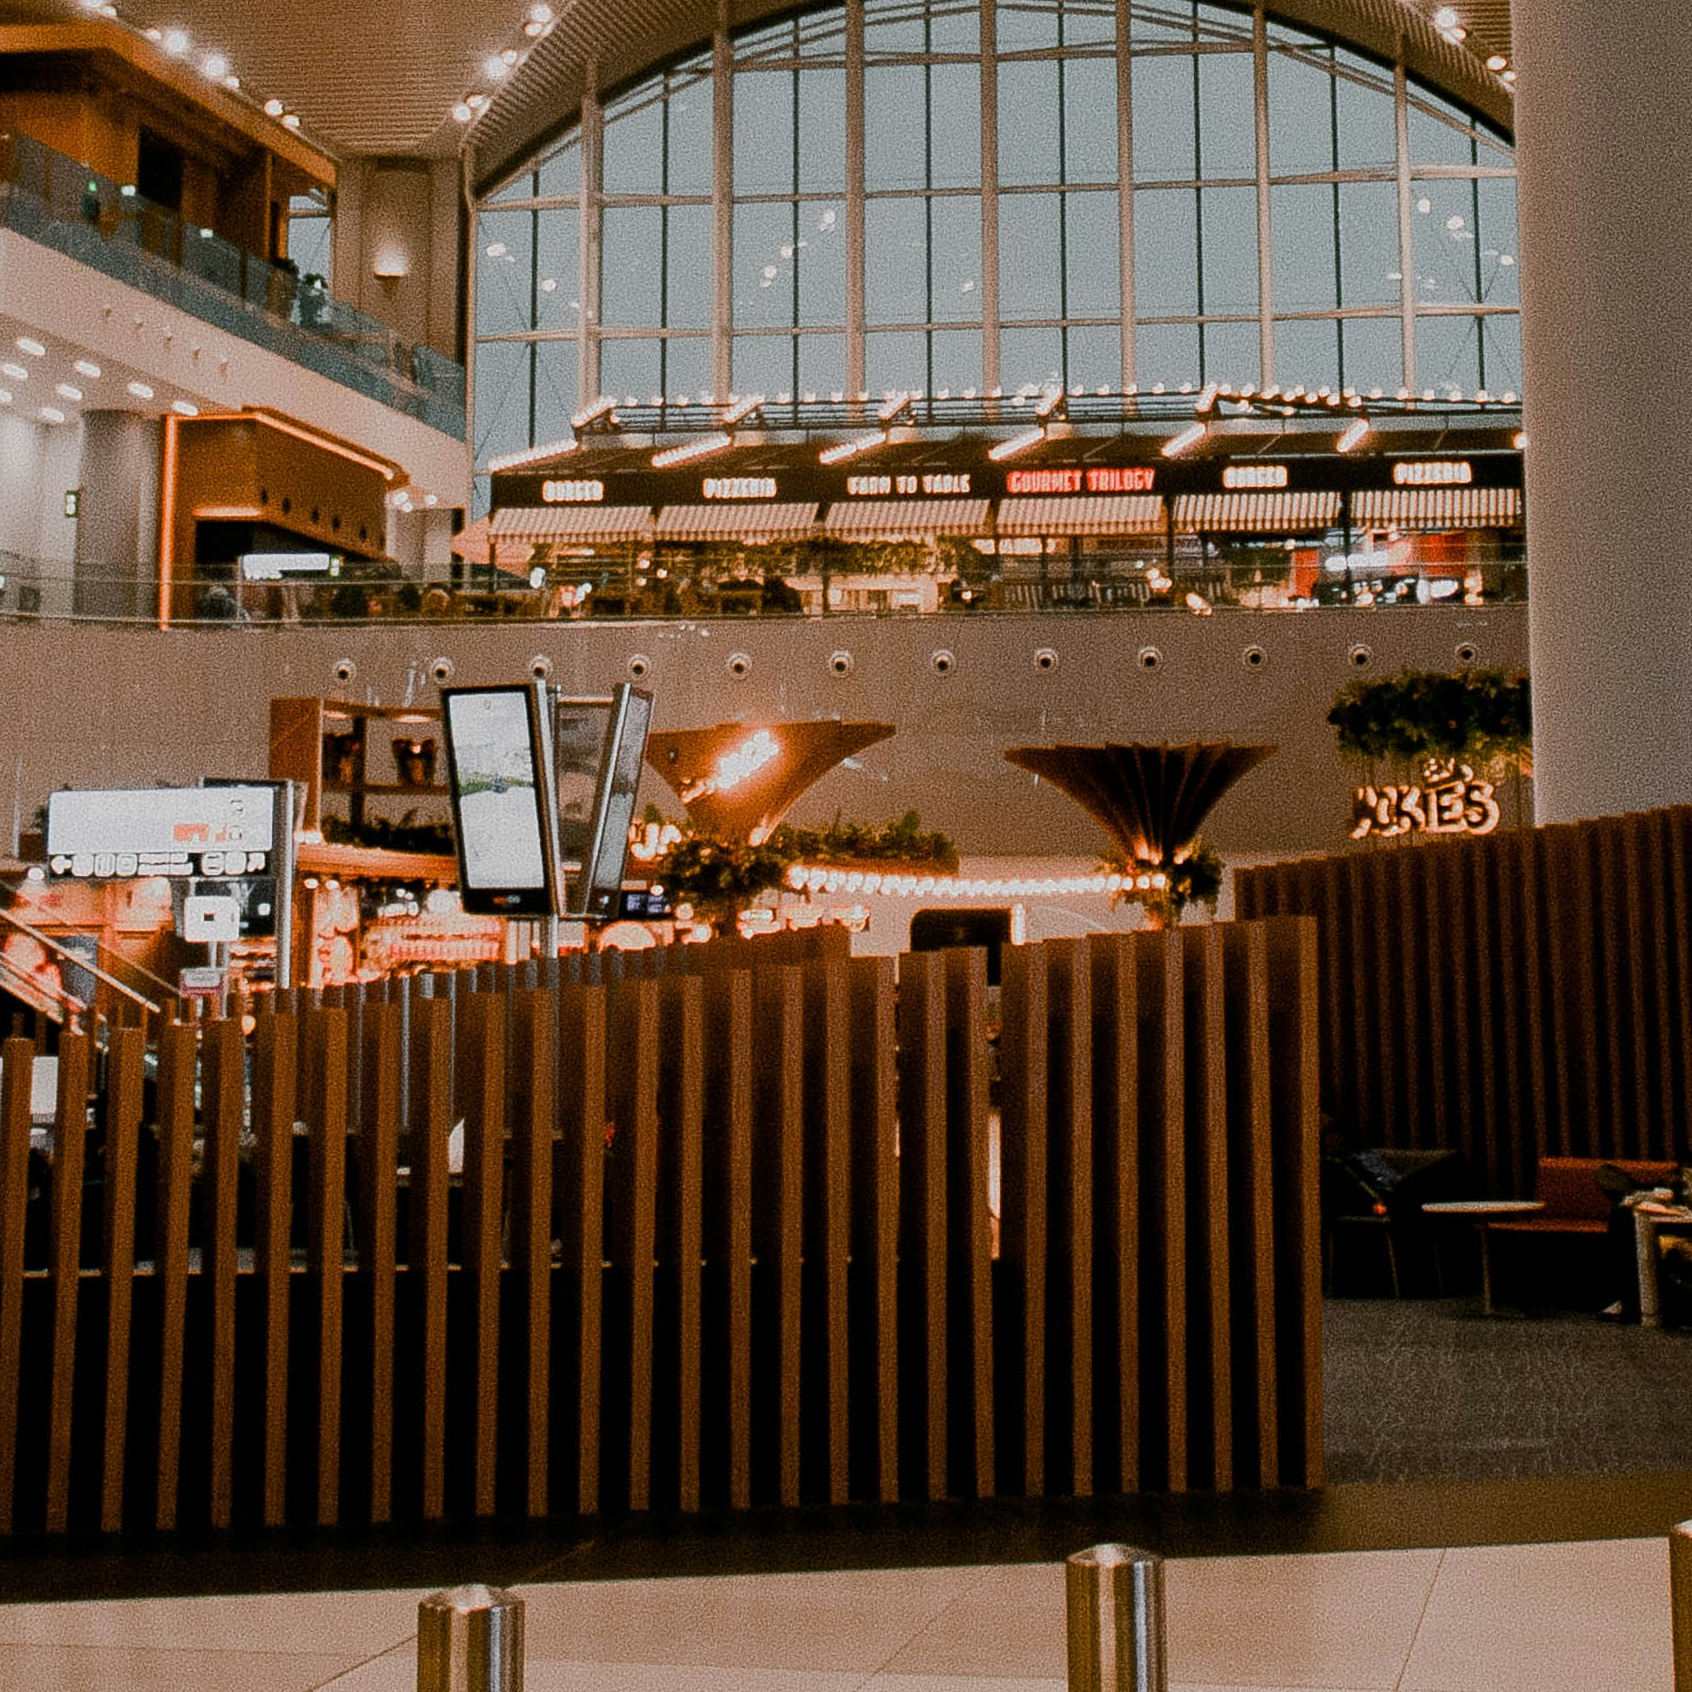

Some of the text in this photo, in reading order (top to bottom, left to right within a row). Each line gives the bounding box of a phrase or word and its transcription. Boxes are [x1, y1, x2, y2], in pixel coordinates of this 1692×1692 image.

[1006, 467, 1155, 493] GOURMET TRILOGY
[1393, 461, 1472, 484] PIZZERIA
[702, 477, 777, 499] PIZZERIA
[847, 474, 970, 495] FARM TO TABLE
